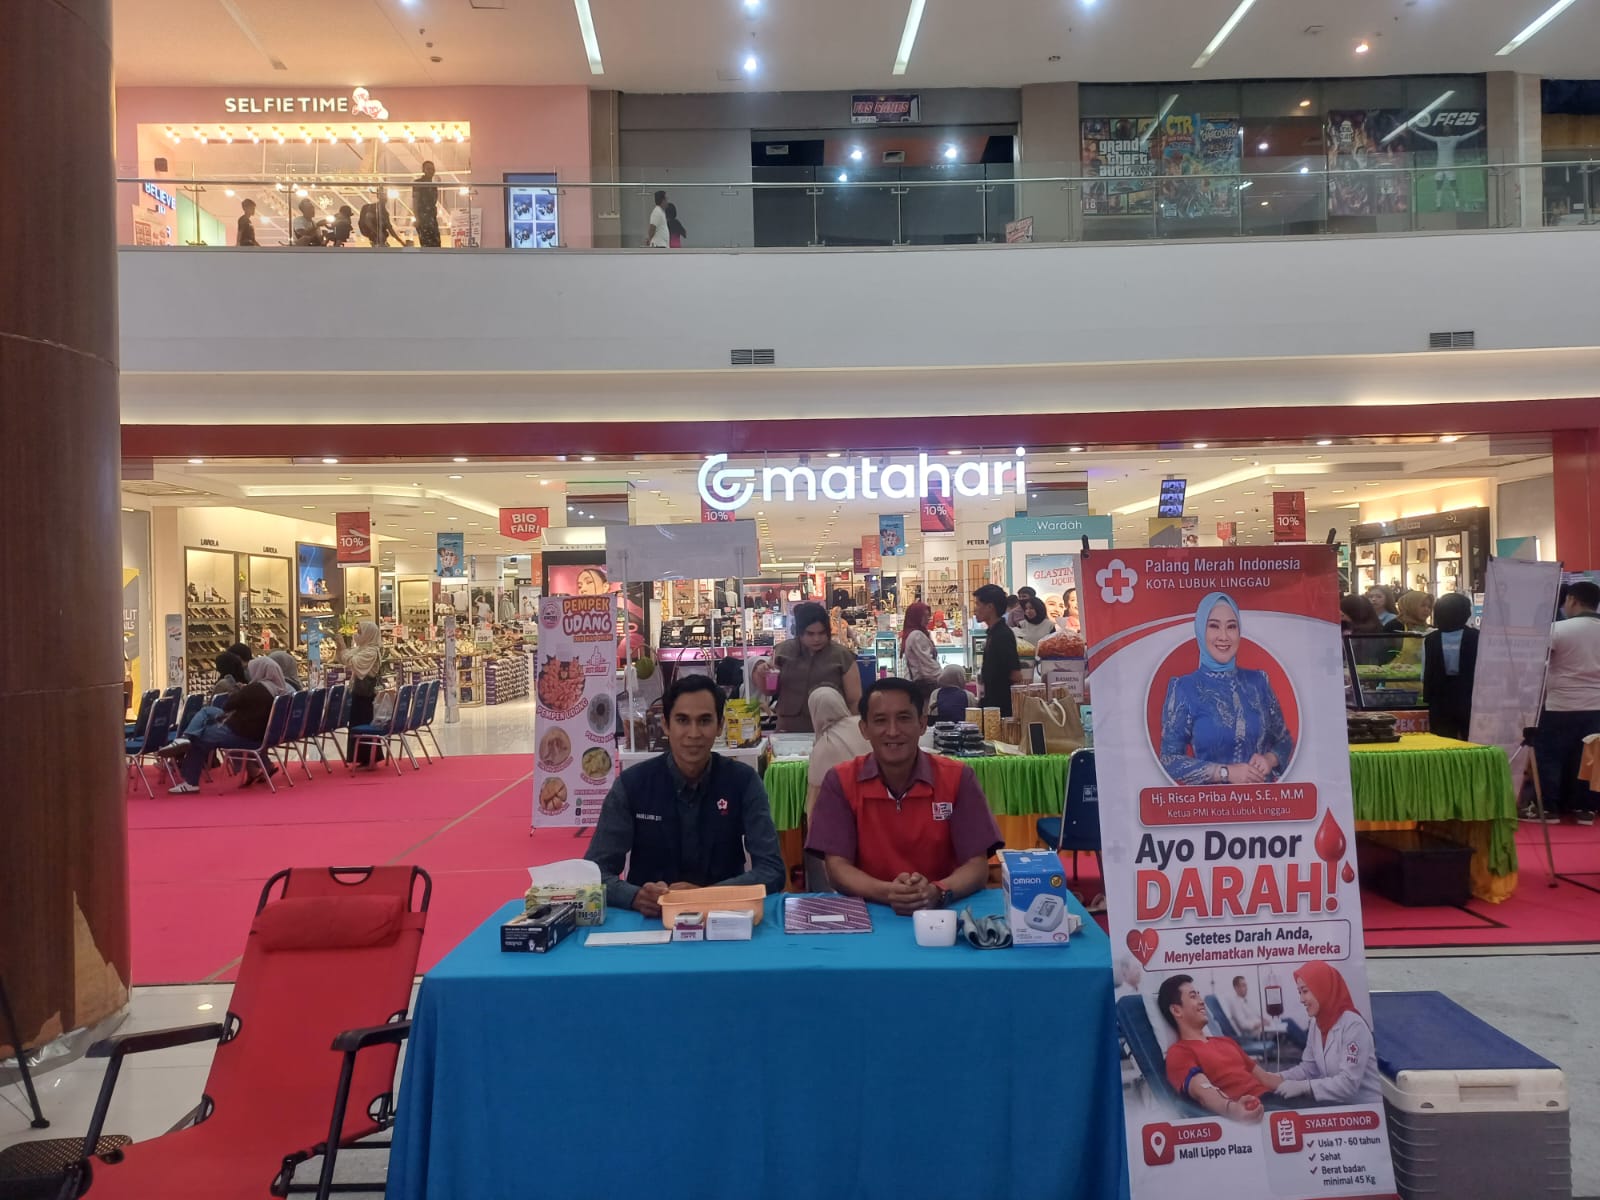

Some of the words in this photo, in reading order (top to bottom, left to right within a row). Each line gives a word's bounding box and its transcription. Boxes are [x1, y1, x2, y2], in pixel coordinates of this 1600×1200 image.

[224, 97, 294, 113] SELFIE
[297, 97, 348, 112] TIME
[1166, 115, 1194, 136] CTR
[1099, 137, 1139, 154] grand
[762, 446, 1026, 502] matahari
[511, 513, 537, 524] BIG
[1036, 520, 1082, 530] Wardah
[510, 523, 541, 534] FAIR!
[1145, 558, 1190, 575] Palang
[1194, 558, 1235, 572] Merah
[1239, 556, 1301, 571] Indonesia
[1145, 579, 1175, 589] KOTA
[1179, 578, 1217, 588] LUBUK
[1220, 577, 1271, 587] LINGGAU
[563, 597, 610, 613] PEMPEK
[563, 613, 612, 635] UDANG
[1151, 793, 1165, 807] Hj.
[1168, 792, 1195, 804] Risca
[1198, 791, 1227, 803] Priba
[1280, 788, 1304, 800] M.M
[1167, 808, 1191, 818] Ketua
[1193, 808, 1209, 817] PMI
[1211, 807, 1230, 816] Kota
[1232, 806, 1256, 816] Lubuk
[1259, 806, 1291, 816] Linggau
[1135, 832, 1195, 870] Ayo
[1204, 830, 1303, 861] Donor
[1013, 877, 1041, 885] OMRON
[1136, 861, 1339, 922] DARAH!
[1185, 932, 1232, 946] Setetes
[1234, 928, 1272, 943] Darah
[1275, 926, 1313, 942] Anda,
[1164, 949, 1254, 965] Menyelamatkan
[1256, 946, 1294, 960] Nyawa
[1297, 943, 1341, 956] Mereka
[1305, 1118, 1338, 1129] SYARAT
[1339, 1116, 1372, 1127] DONOR
[1178, 1129, 1211, 1140] LOKASI
[1318, 1139, 1334, 1148] Usia
[1335, 1138, 1342, 1147] 17
[1348, 1137, 1358, 1145] 60
[1359, 1136, 1381, 1145] tahun
[1179, 1147, 1199, 1159] Mall
[1201, 1145, 1225, 1160] Lippo
[1228, 1143, 1253, 1155] Plaza
[1320, 1152, 1341, 1161] Sehat
[1321, 1165, 1342, 1175] Berat
[1343, 1164, 1366, 1173] badan
[1323, 1176, 1354, 1186] minimal
[1355, 1175, 1365, 1184] 45
[1366, 1175, 1376, 1185] Kg
